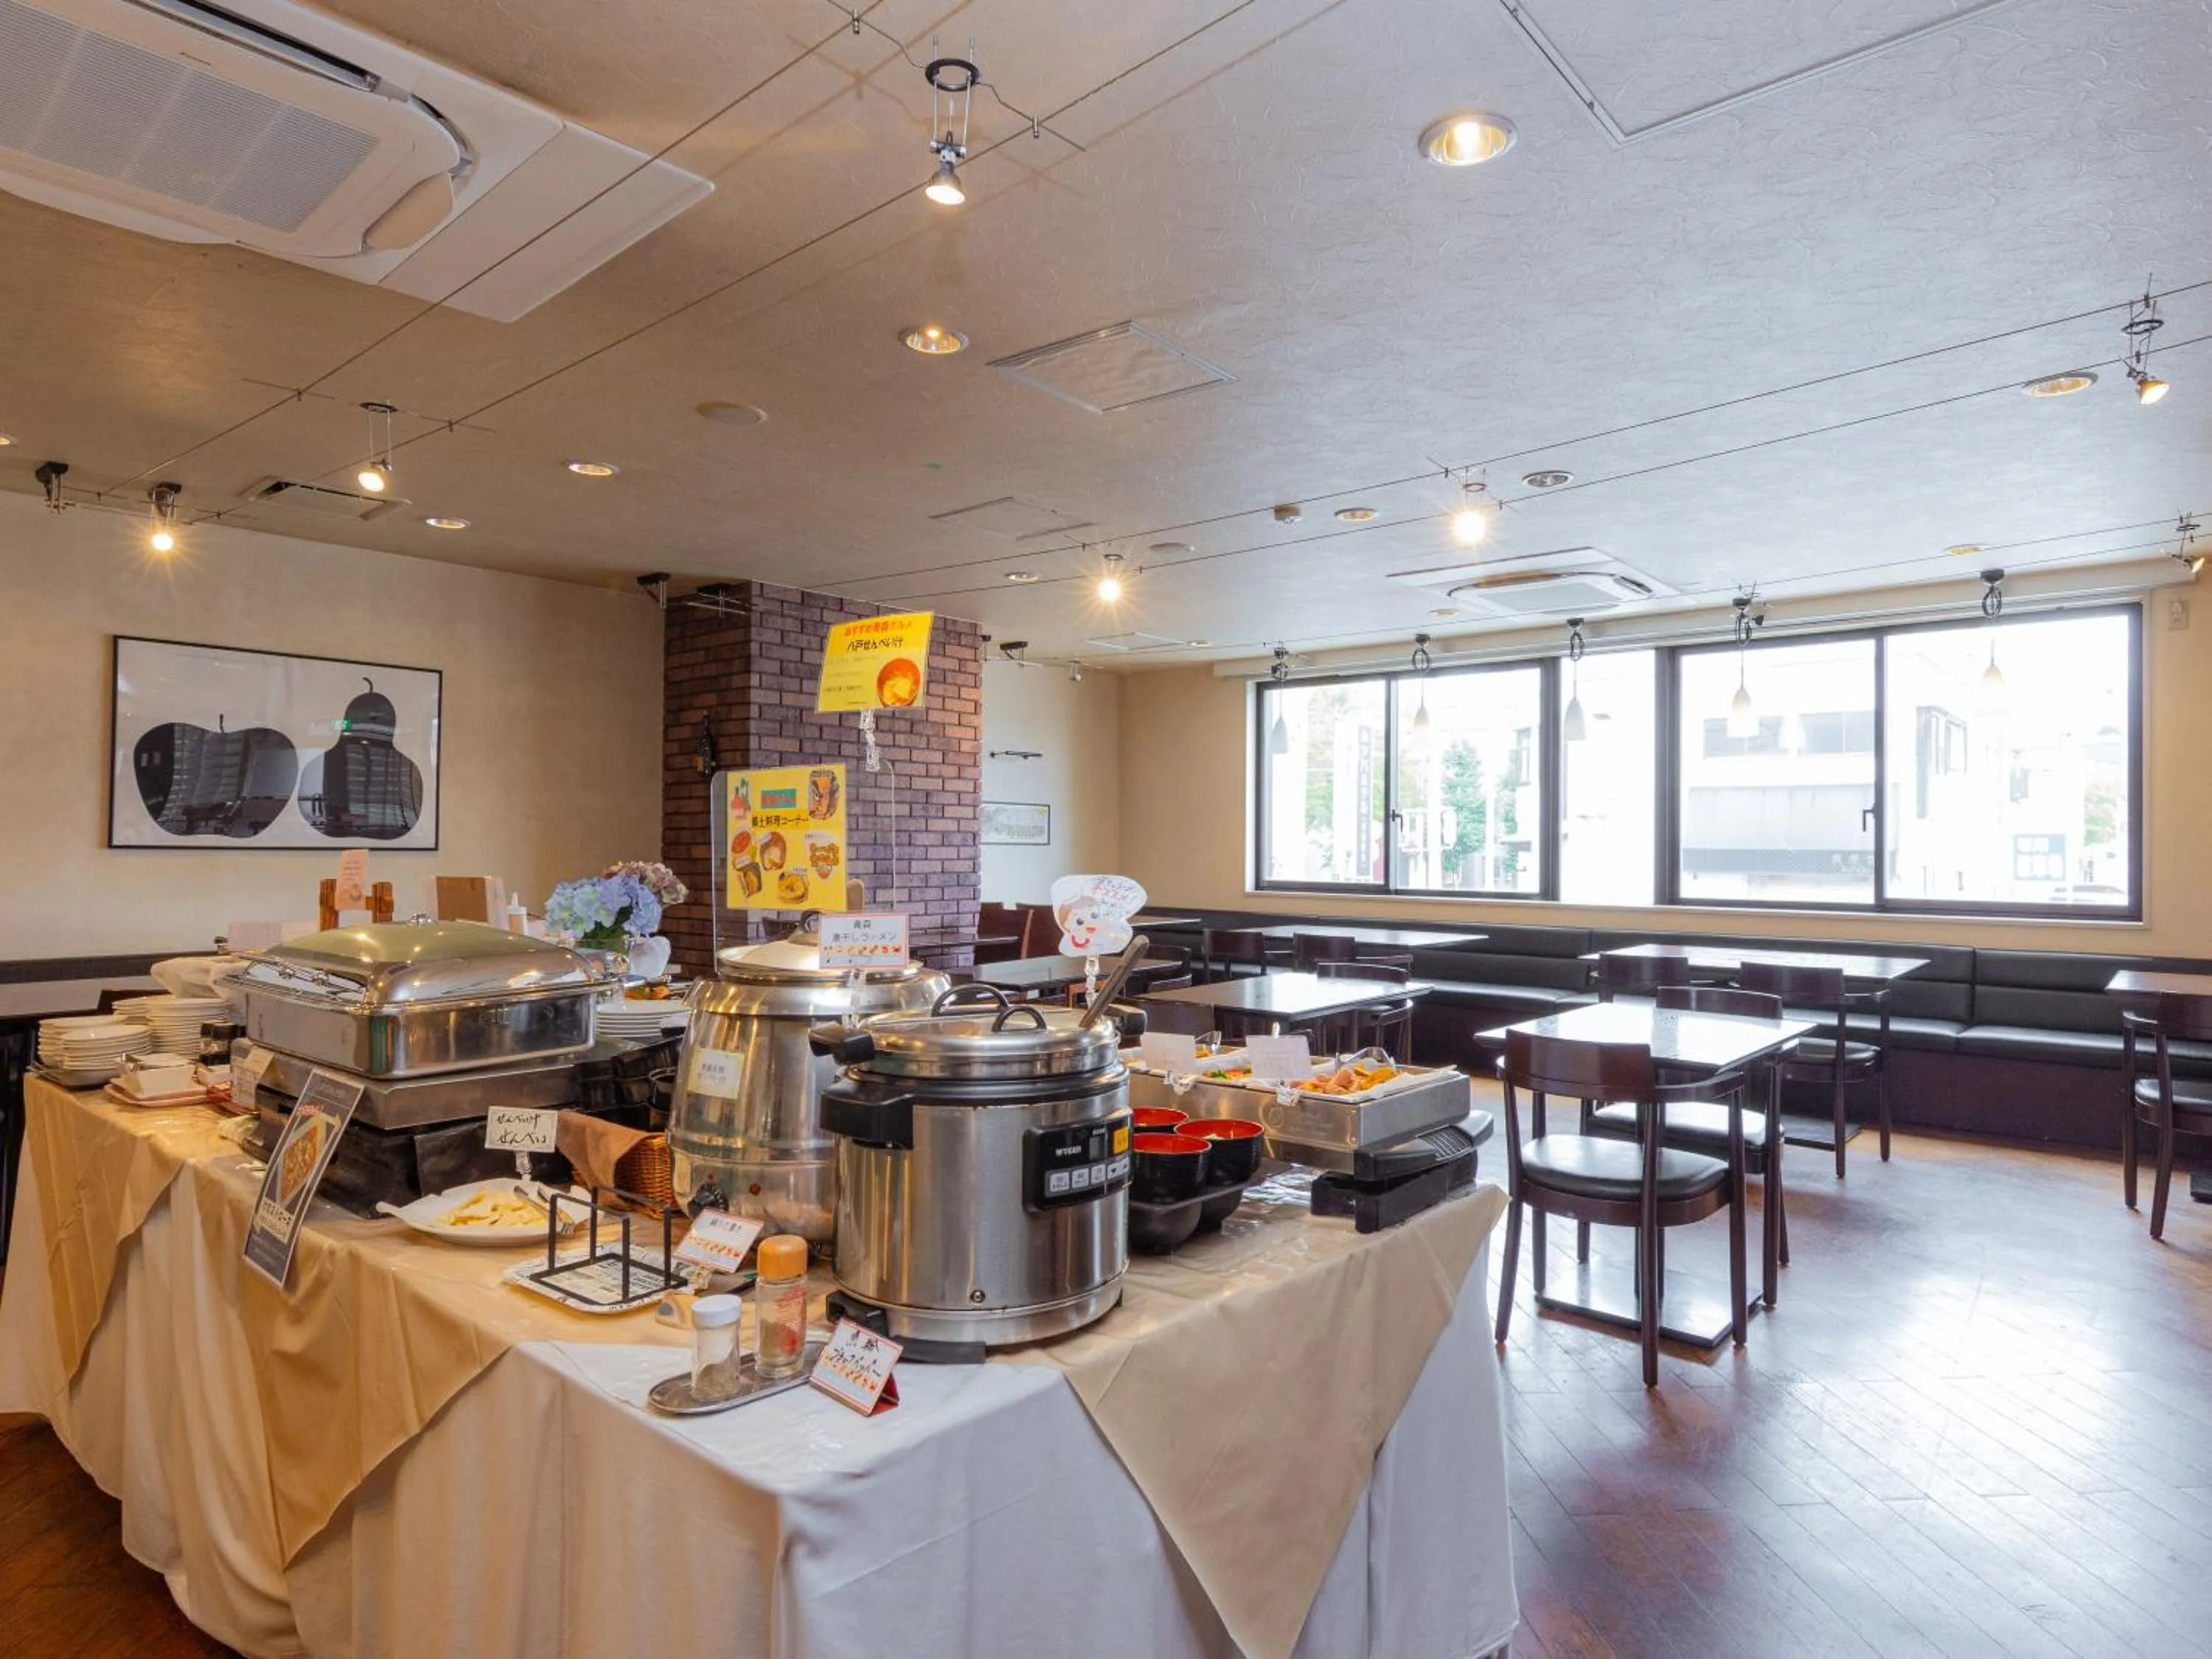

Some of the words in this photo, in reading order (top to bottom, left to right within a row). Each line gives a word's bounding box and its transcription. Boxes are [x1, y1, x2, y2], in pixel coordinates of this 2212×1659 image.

[846, 636, 903, 652] 八戸せんべい汁
